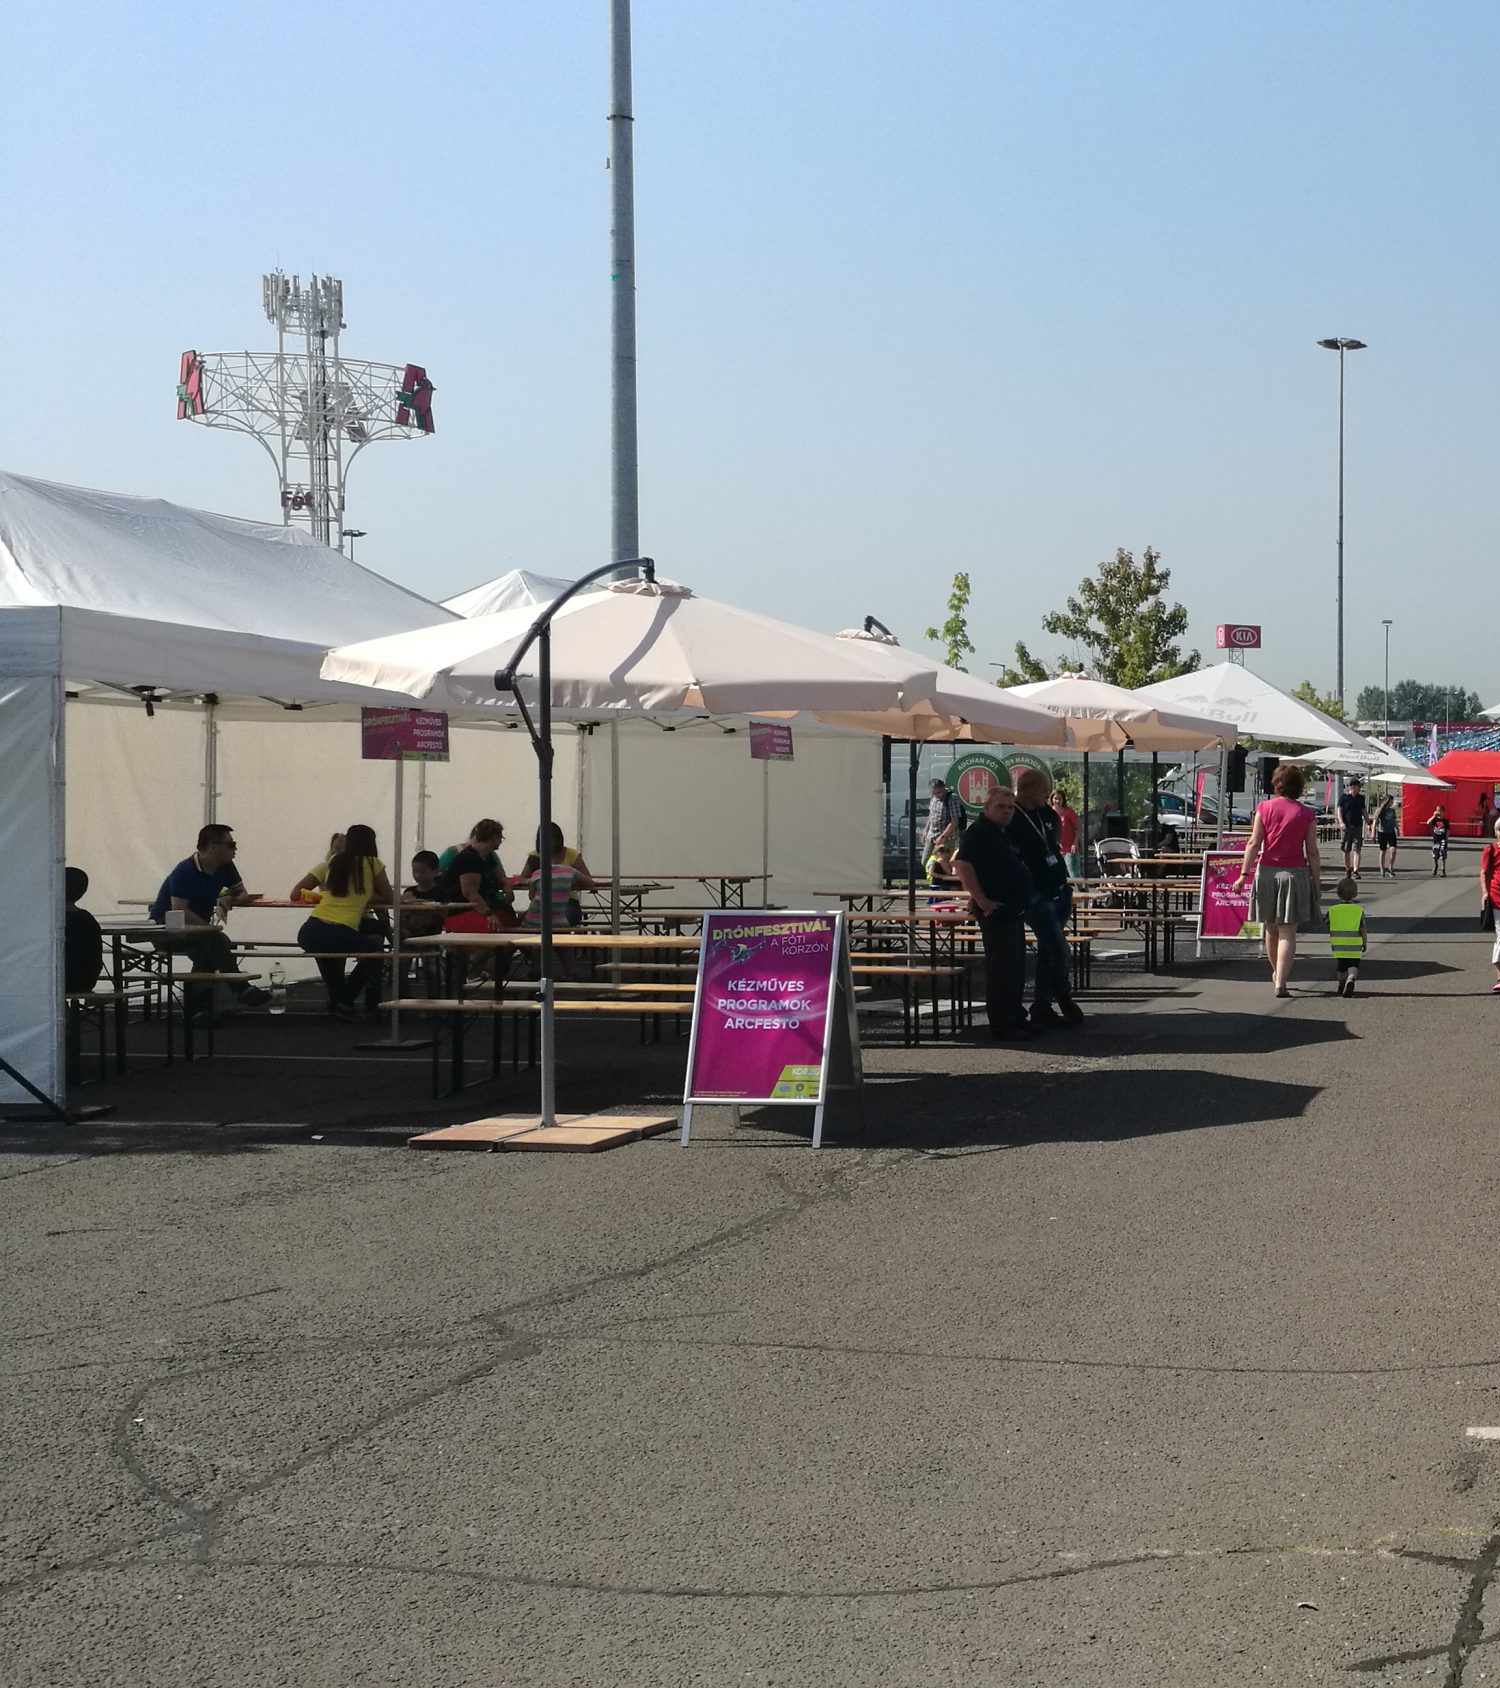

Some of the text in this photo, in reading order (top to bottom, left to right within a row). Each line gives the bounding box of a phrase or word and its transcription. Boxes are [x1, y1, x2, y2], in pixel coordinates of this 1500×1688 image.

[1236, 631, 1253, 641] KIA
[1208, 709, 1258, 723] Bull
[958, 758, 984, 770] AUCHAN
[713, 919, 831, 940] DRÓNFESZTIVÁL
[771, 935, 806, 947] A FÓTI
[782, 942, 829, 955] KORZÓN
[728, 978, 805, 991] KÉZMŰVES
[718, 999, 811, 1011] PROGRAMOK
